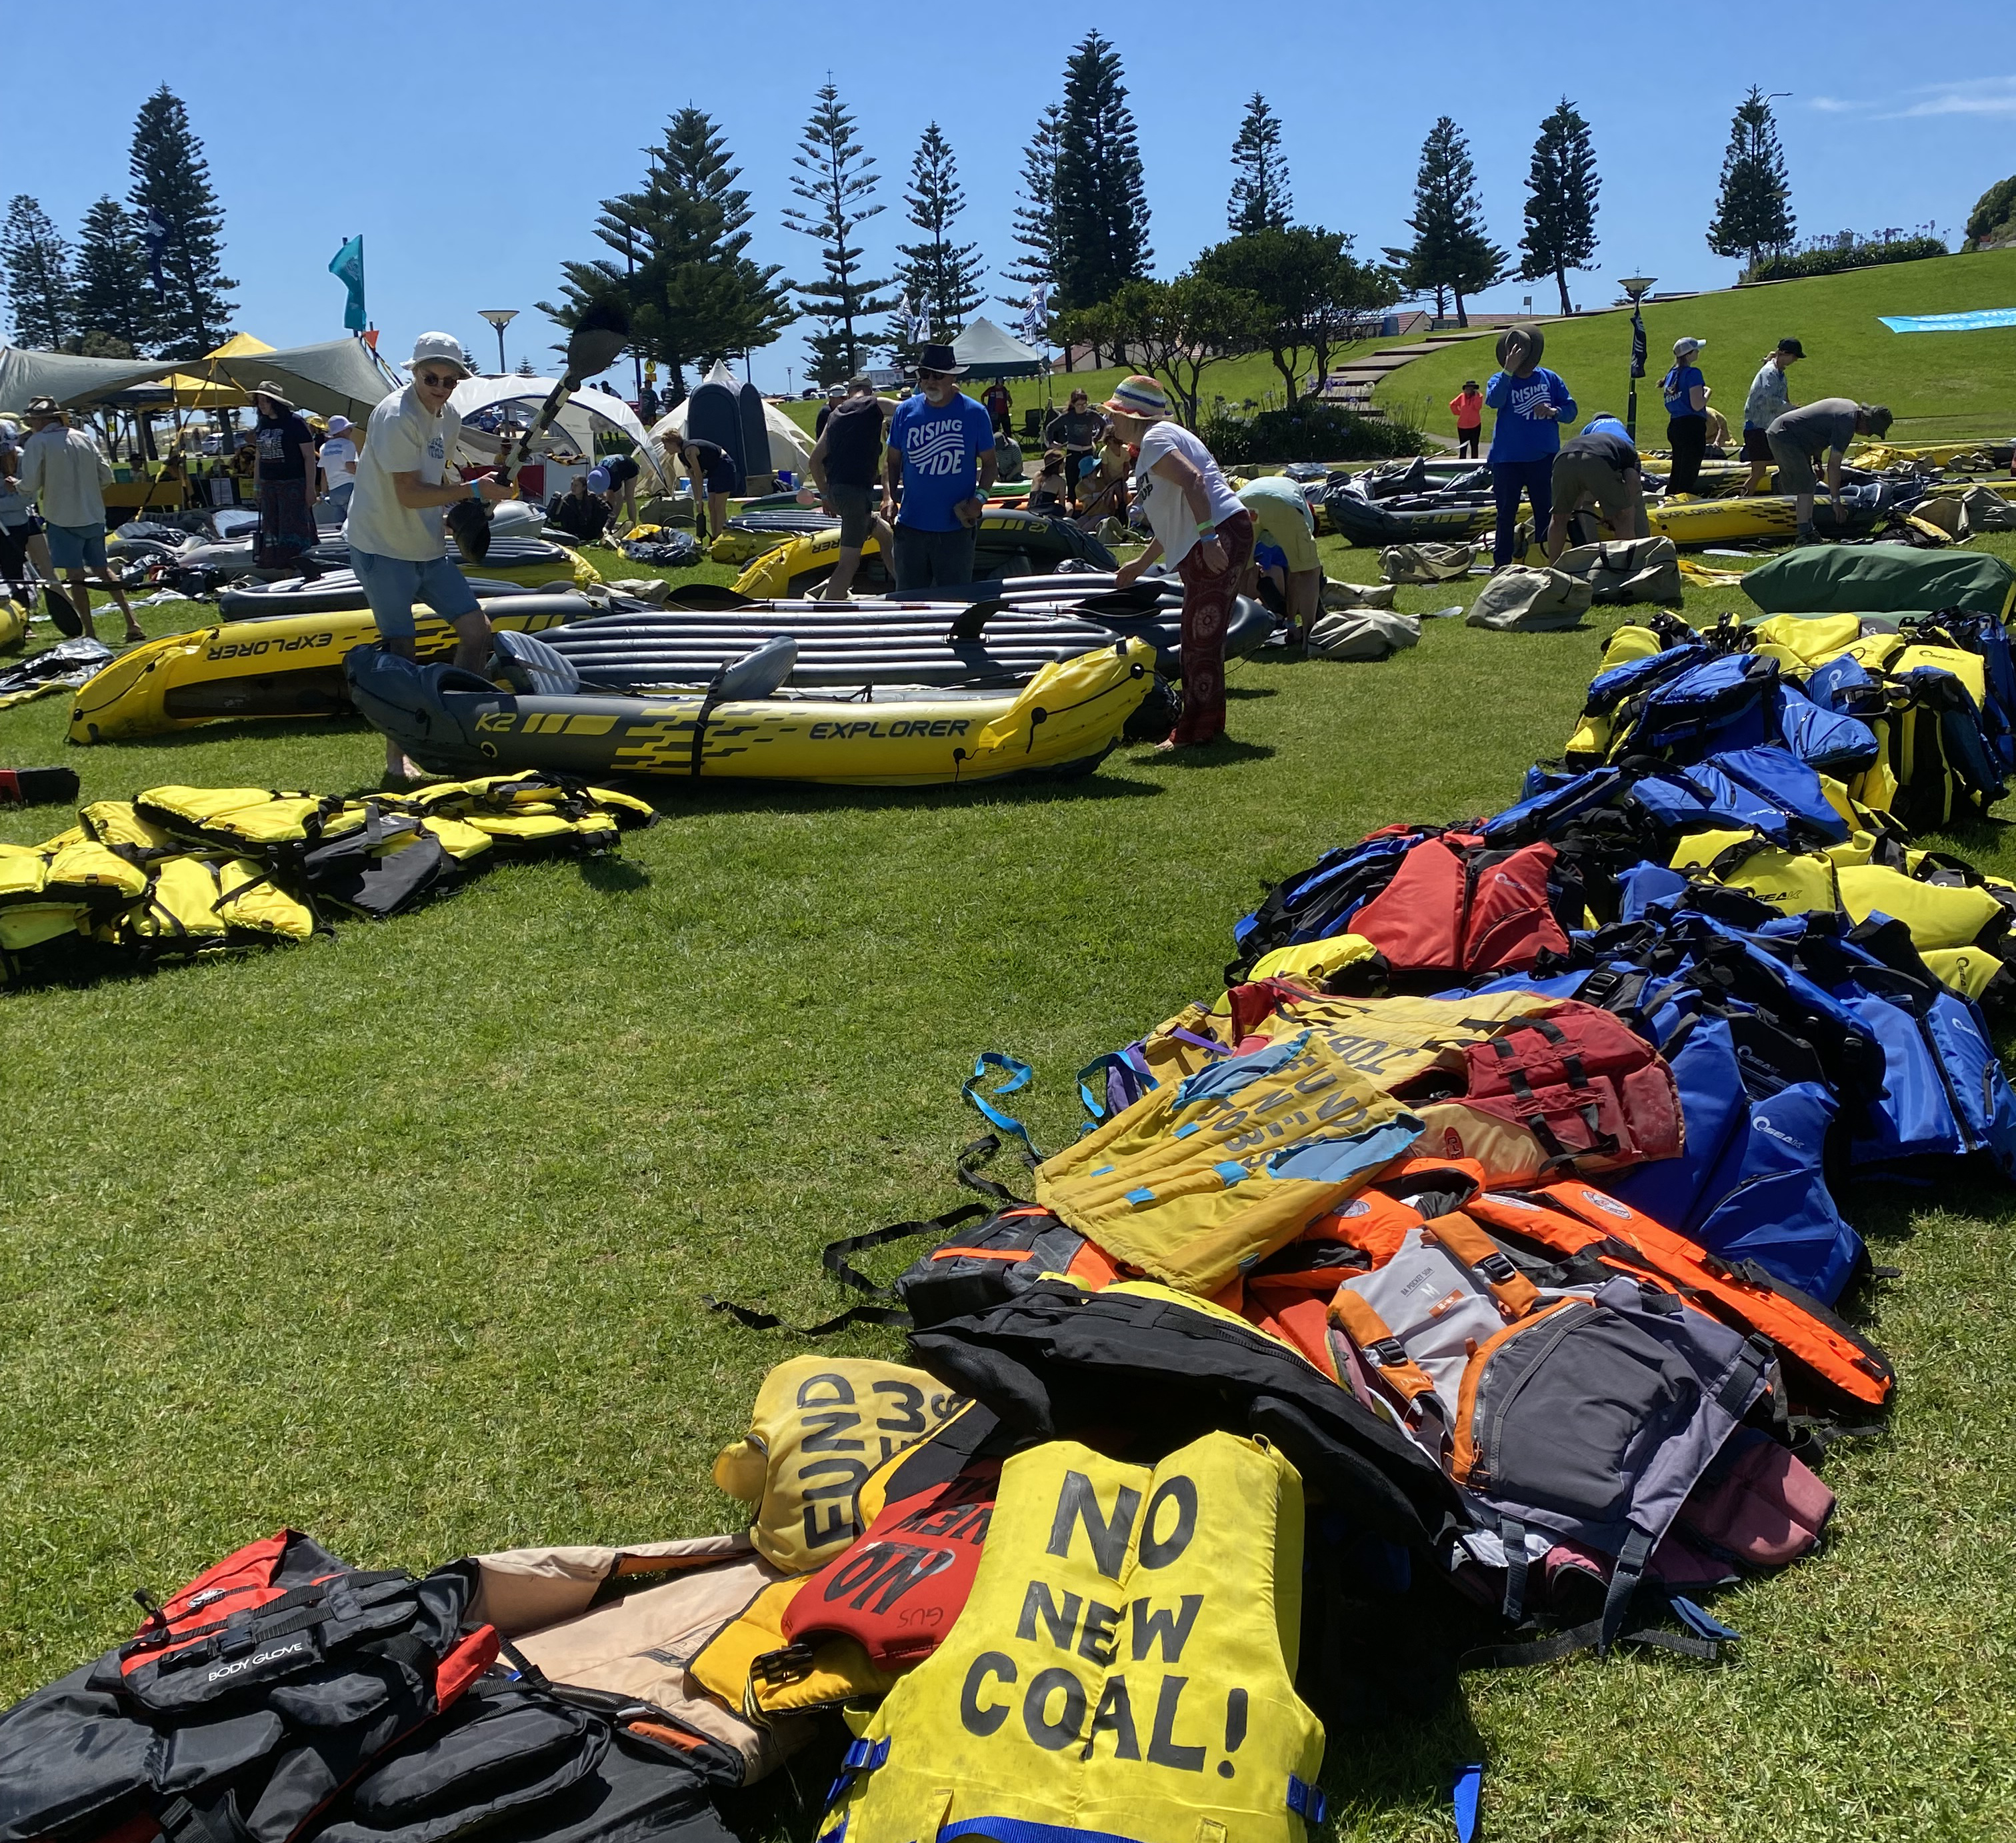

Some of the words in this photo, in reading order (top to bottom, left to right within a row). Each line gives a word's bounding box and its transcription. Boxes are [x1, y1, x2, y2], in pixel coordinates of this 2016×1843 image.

[1511, 383, 1548, 404] RISING
[907, 419, 963, 448] RISING
[916, 449, 965, 475] TIDE
[1411, 515, 1430, 524] K2
[1657, 506, 1727, 519] EXPLORER
[206, 632, 333, 661] EXPLORER
[475, 712, 517, 732] K2
[809, 719, 971, 739] EXPLORER
[1752, 1116, 1805, 1149] OSEAK
[1407, 1274, 1424, 1290] POCKET
[1420, 1283, 1440, 1300] M
[797, 1373, 871, 1550] FUND
[1045, 1469, 1199, 1582] NO
[823, 1541, 956, 1615] NO
[896, 1606, 944, 1628] GUS
[1015, 1580, 1205, 1668] NEW
[208, 1658, 250, 1682] BODY
[252, 1642, 303, 1664] GLOVE
[959, 1650, 1249, 1779] COAL!
